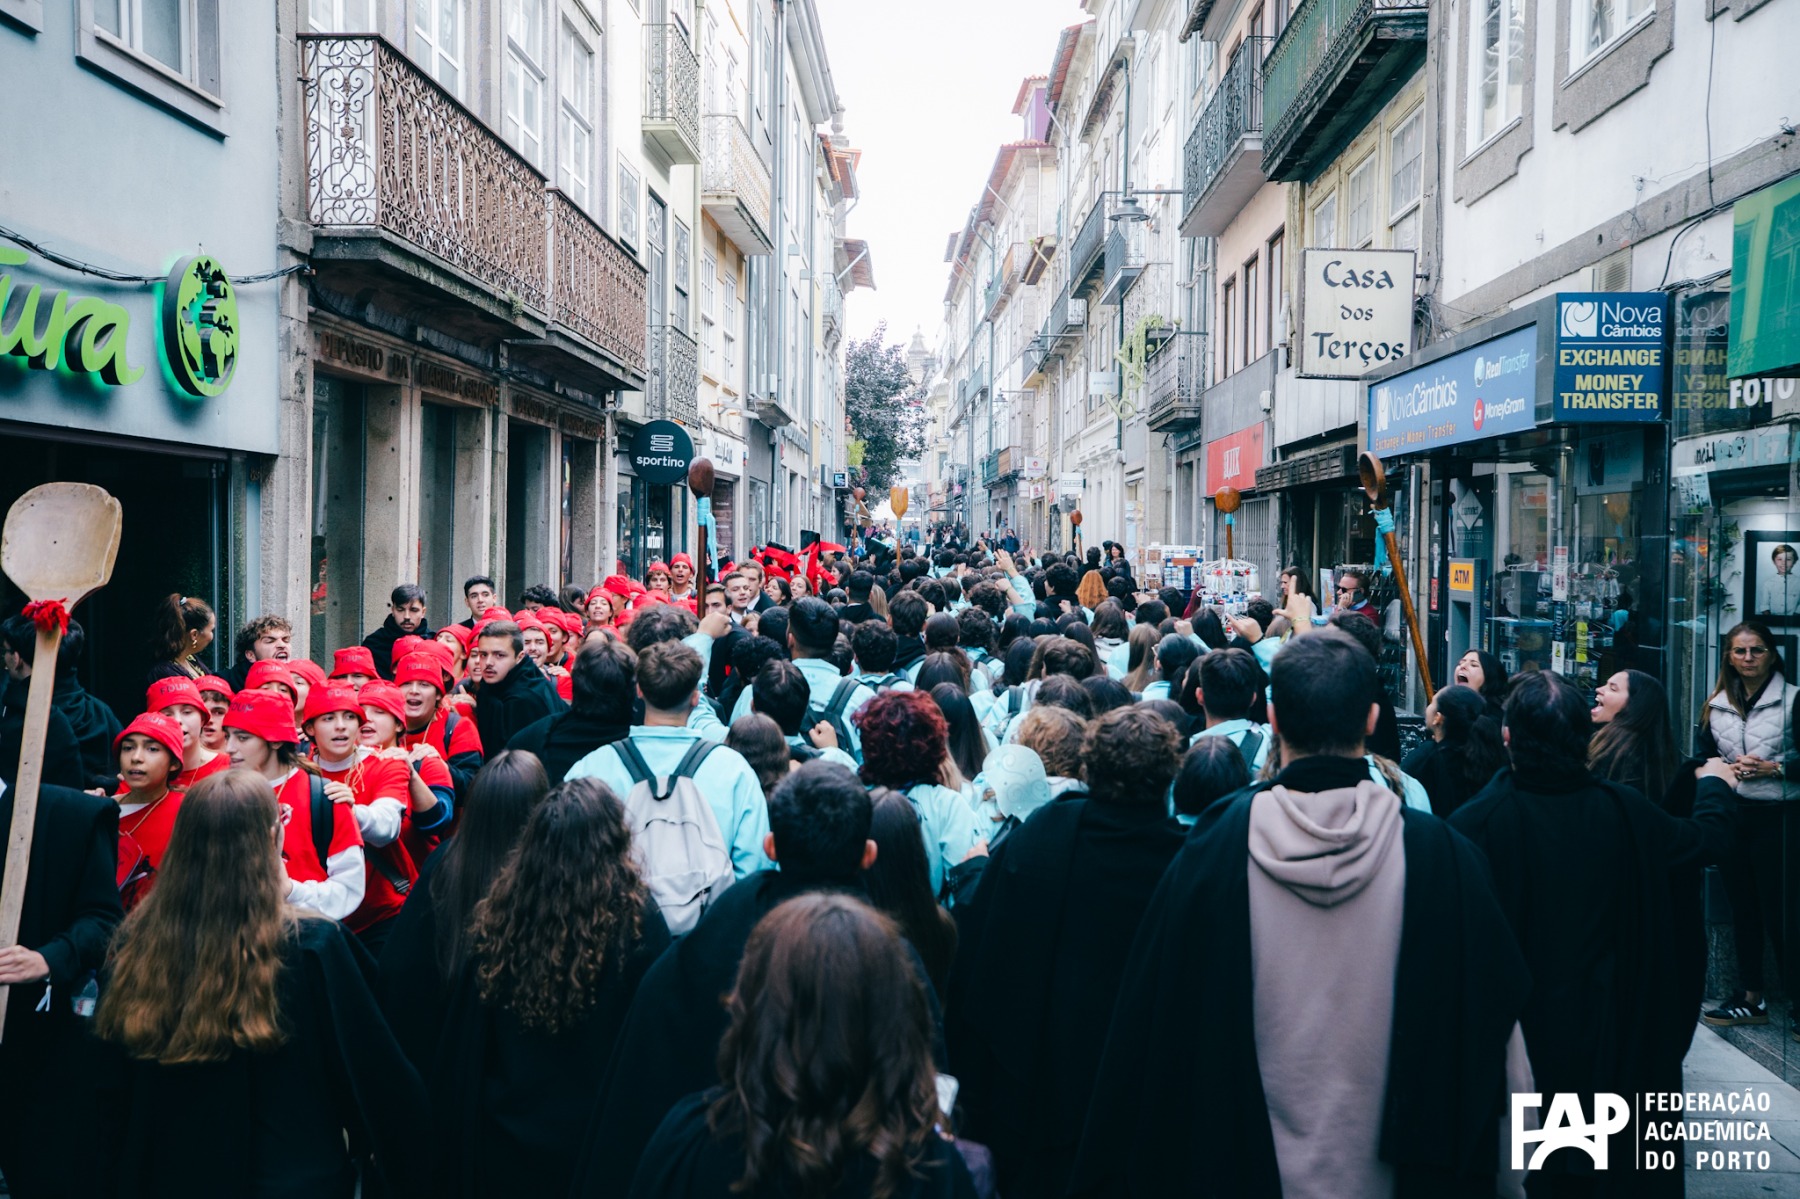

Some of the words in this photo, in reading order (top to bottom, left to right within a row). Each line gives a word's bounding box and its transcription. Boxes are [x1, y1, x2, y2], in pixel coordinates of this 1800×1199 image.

[1323, 260, 1394, 289] Casa
[0, 246, 145, 386] ura
[1340, 303, 1373, 321] dos
[1602, 302, 1662, 323] Nova
[1602, 324, 1662, 337] Câmbios
[1310, 331, 1404, 368] Terços
[1560, 350, 1661, 366] EXCHANGE
[1575, 374, 1644, 391] MONEY
[1560, 393, 1659, 409] TRANSFER
[1729, 377, 1796, 409] FOTO
[1485, 398, 1525, 420] MoneyGram
[1375, 433, 1399, 451] Exchange
[1407, 429, 1426, 444] Money
[1428, 421, 1457, 440] Transfer
[636, 455, 685, 467] sportino
[1454, 569, 1470, 585] ATM
[160, 683, 190, 695] FDUP
